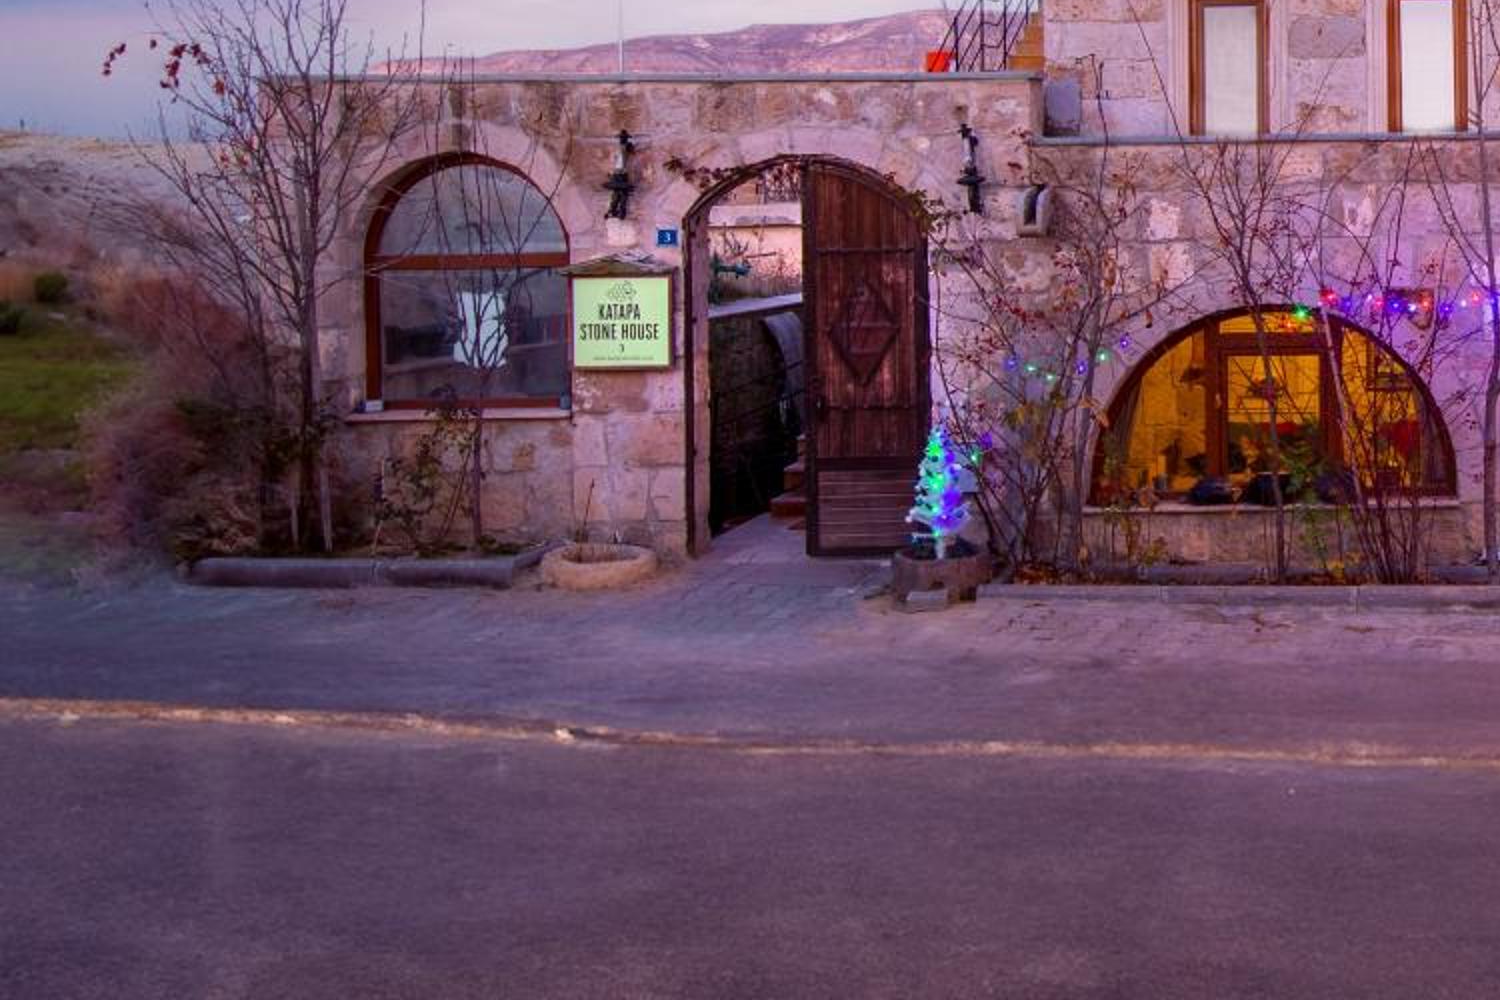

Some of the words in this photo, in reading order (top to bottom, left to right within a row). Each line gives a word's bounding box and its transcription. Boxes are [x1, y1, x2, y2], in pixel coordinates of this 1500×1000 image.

[664, 231, 671, 242] 3
[598, 303, 641, 320] KATAPA
[580, 323, 618, 340] STONE
[621, 323, 659, 340] HOUSE
